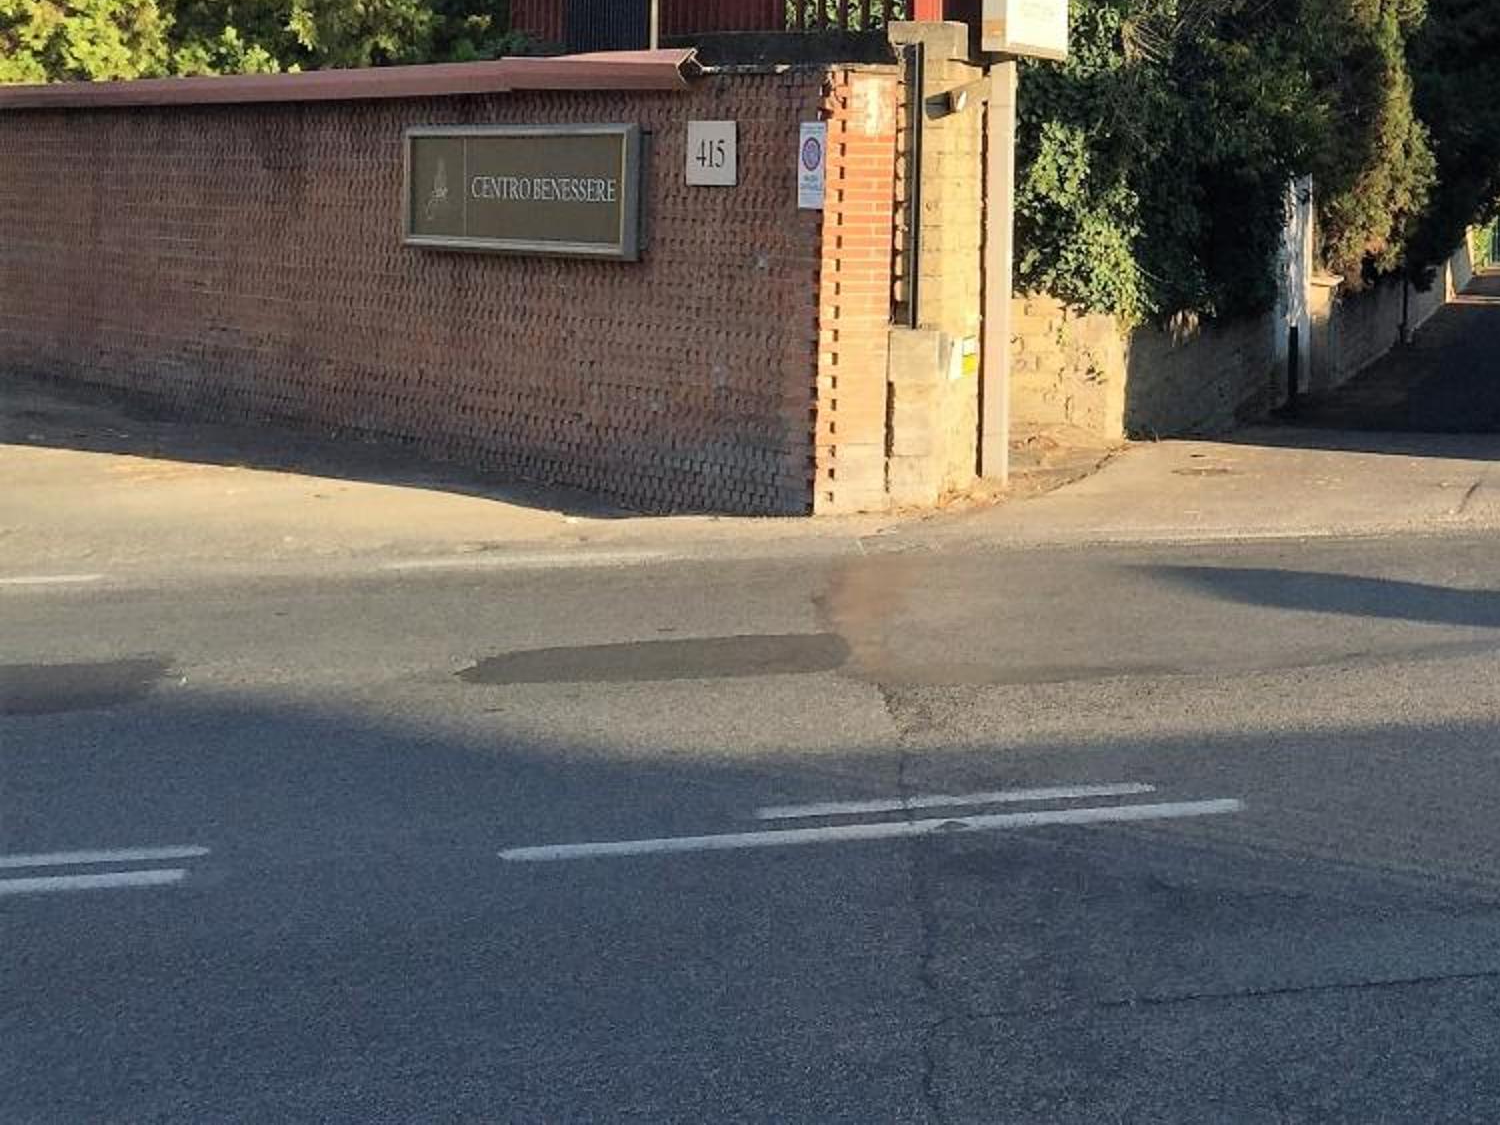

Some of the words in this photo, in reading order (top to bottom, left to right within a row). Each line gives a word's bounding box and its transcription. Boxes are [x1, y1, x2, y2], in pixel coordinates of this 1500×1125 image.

[695, 139, 725, 168] 415
[471, 176, 531, 201] CENTRO
[532, 178, 617, 203] BENESSERE
